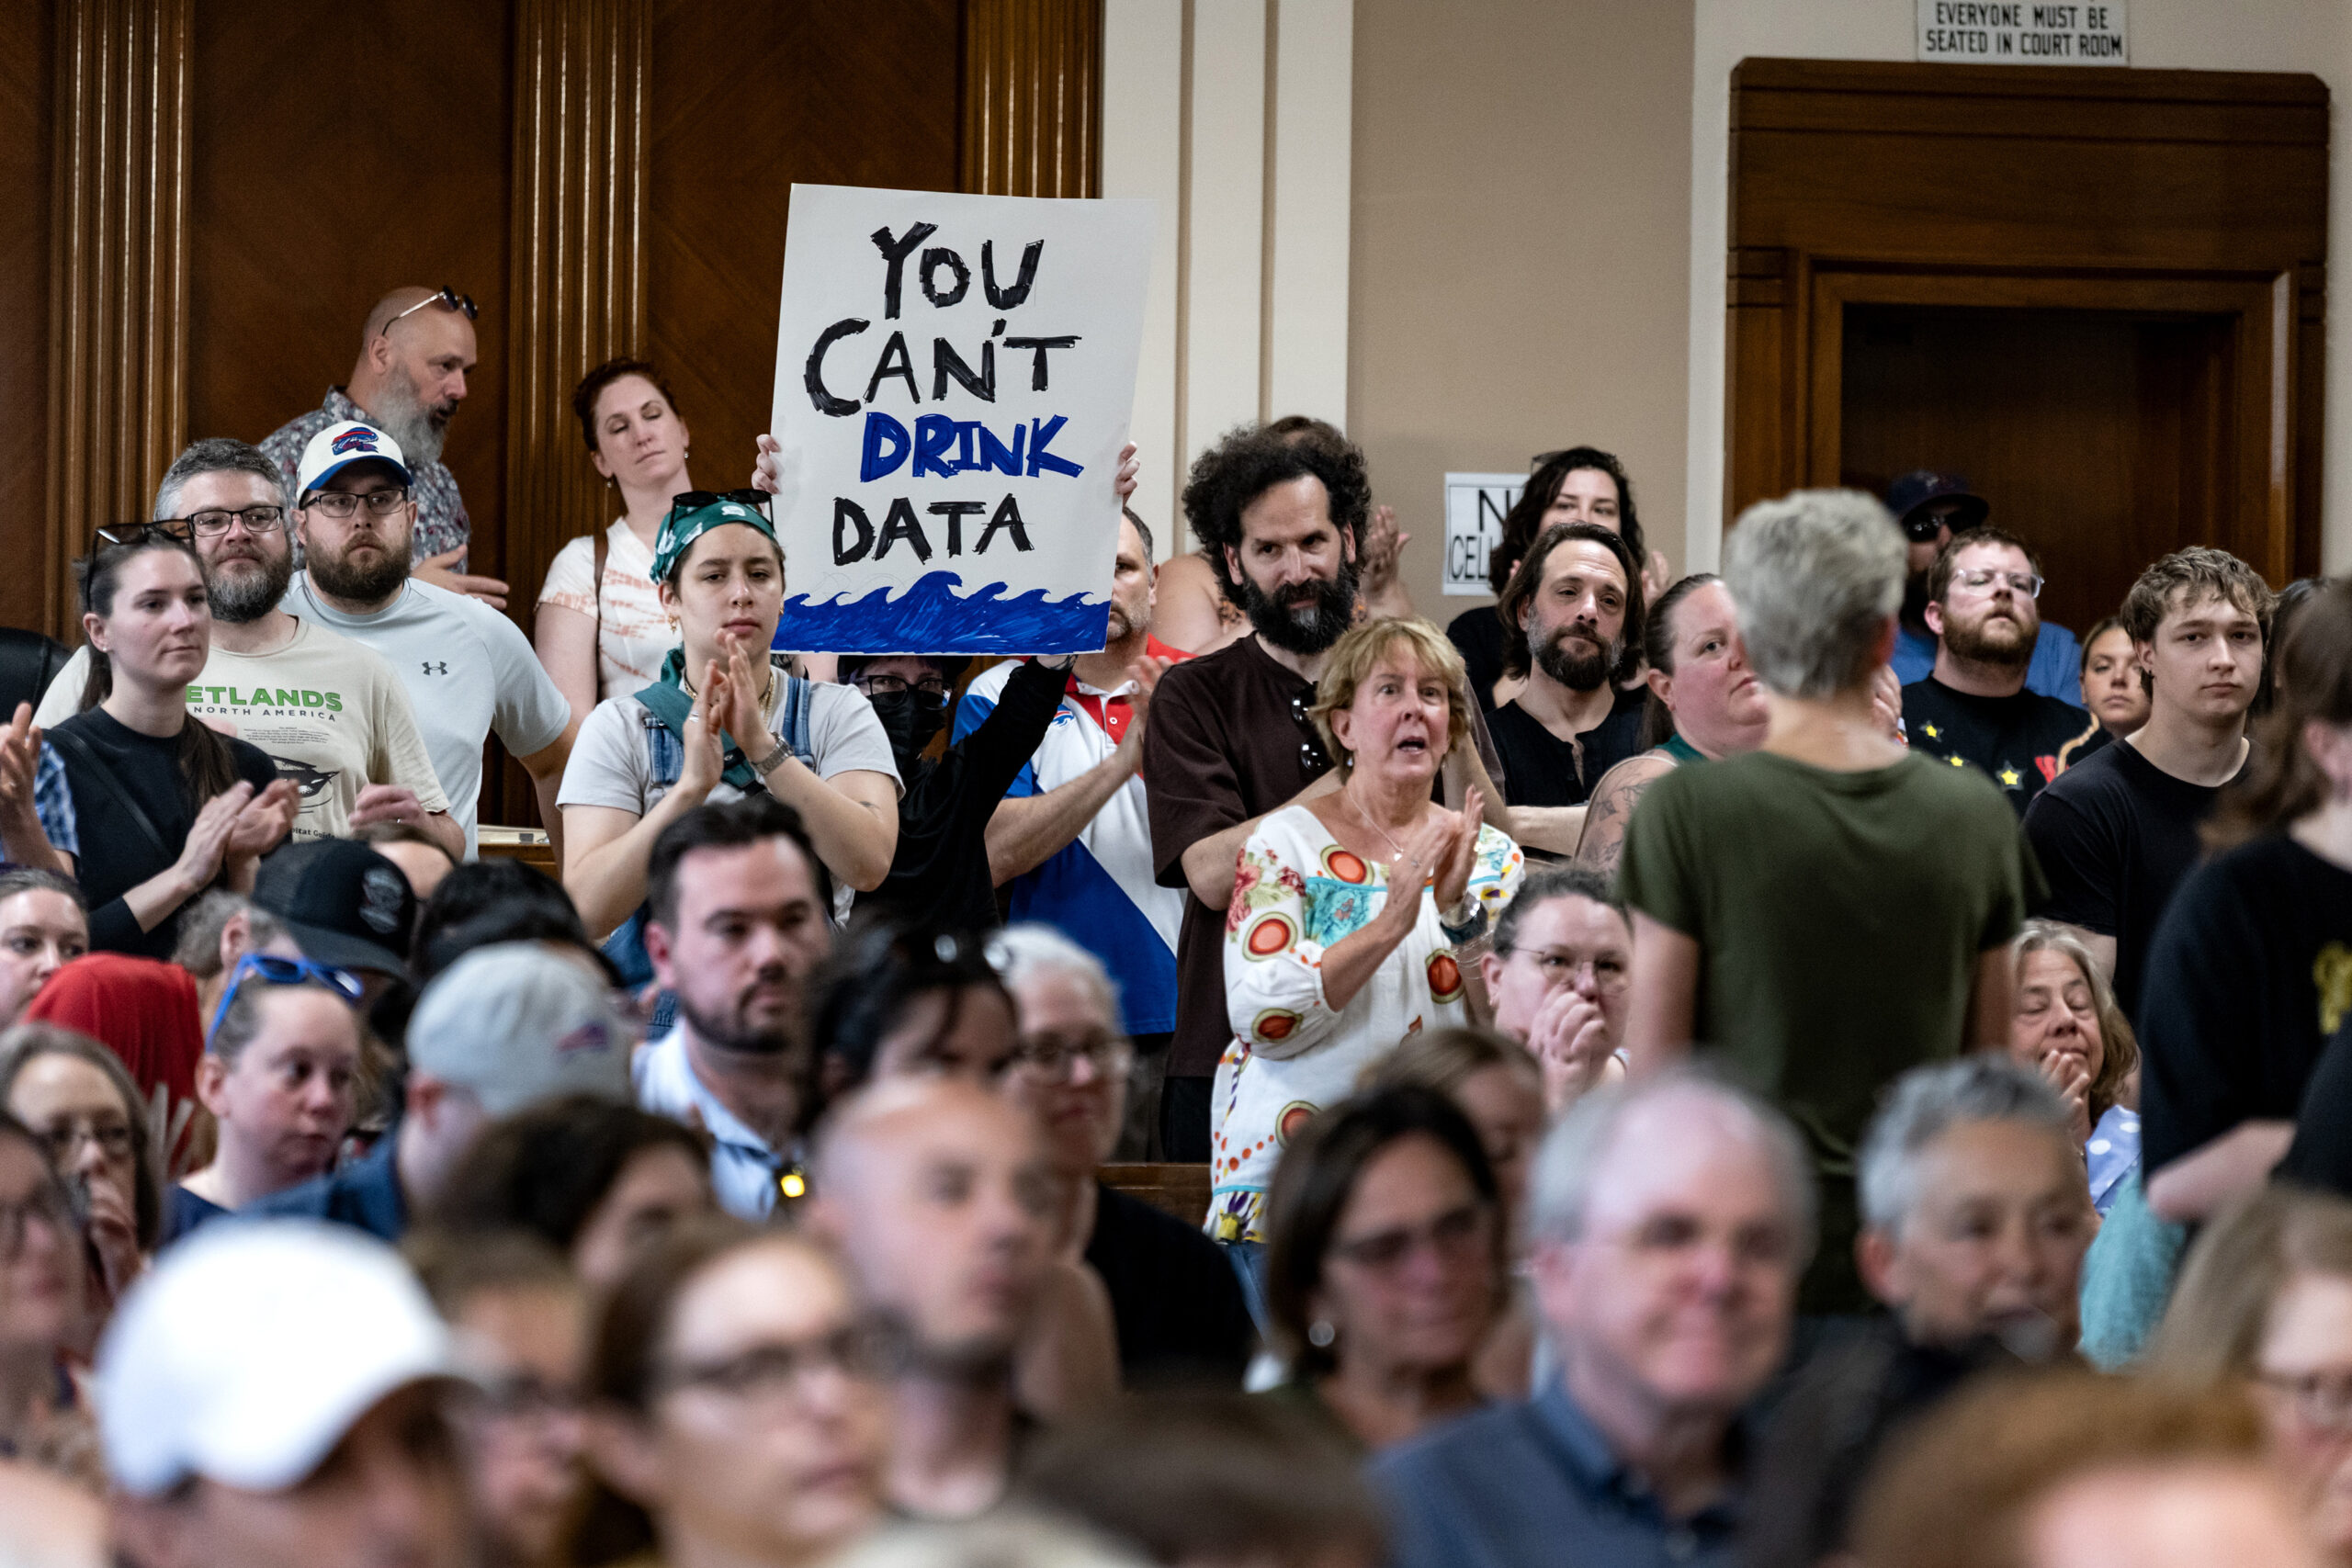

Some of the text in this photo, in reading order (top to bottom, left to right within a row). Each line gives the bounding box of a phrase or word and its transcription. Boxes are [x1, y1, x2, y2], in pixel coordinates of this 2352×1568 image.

[1936, 3, 2109, 29] EVERYONE MUST BE
[1927, 30, 2122, 57] SEATED IN COURT ROOM
[871, 221, 1045, 320] YOU
[804, 318, 1081, 417] CAN'T
[860, 412, 1084, 482] DRINK
[833, 492, 1035, 566] DATA
[186, 685, 343, 712] ETLANDS
[194, 706, 335, 722] NORTH AMERICA
